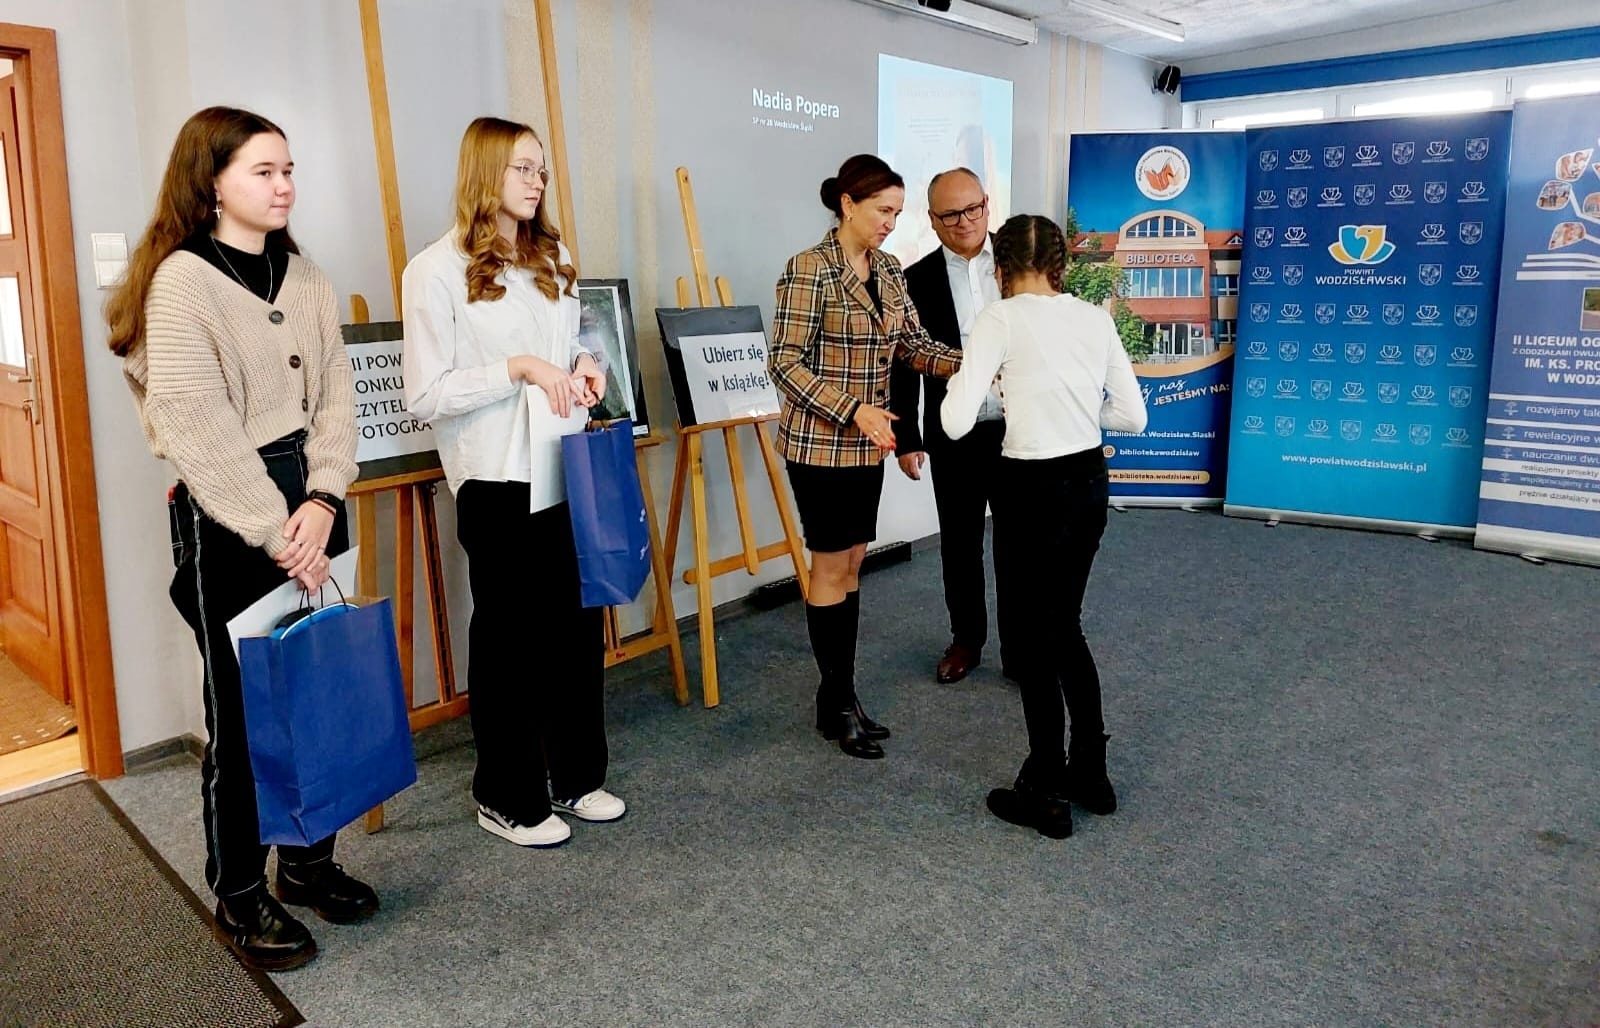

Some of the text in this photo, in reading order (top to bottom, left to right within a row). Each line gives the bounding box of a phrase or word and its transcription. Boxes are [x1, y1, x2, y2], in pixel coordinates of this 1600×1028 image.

[752, 87, 840, 119] Nadia Popera
[1127, 253, 1196, 264] BIBLIOTEKA
[1315, 276, 1406, 285] WODZISŁAWSKI
[1513, 335, 1521, 345] II
[1525, 335, 1577, 347] LICEUM
[702, 344, 764, 364] Ubierz się
[1525, 358, 1544, 368] IM.
[1548, 359, 1571, 369] KS.
[708, 370, 770, 393] w książkę!
[1547, 373, 1560, 383] W
[1159, 379, 1187, 393] nas
[1153, 386, 1207, 406] JESTEŚMY
[1210, 384, 1230, 394] NA:
[1526, 406, 1579, 417] rozwijamy
[358, 419, 433, 440] OTOGRA
[1524, 431, 1590, 443] rewelacyjne
[1522, 451, 1577, 462] nauczanie
[1281, 454, 1427, 473] www.powiatwodzislawski.pl
